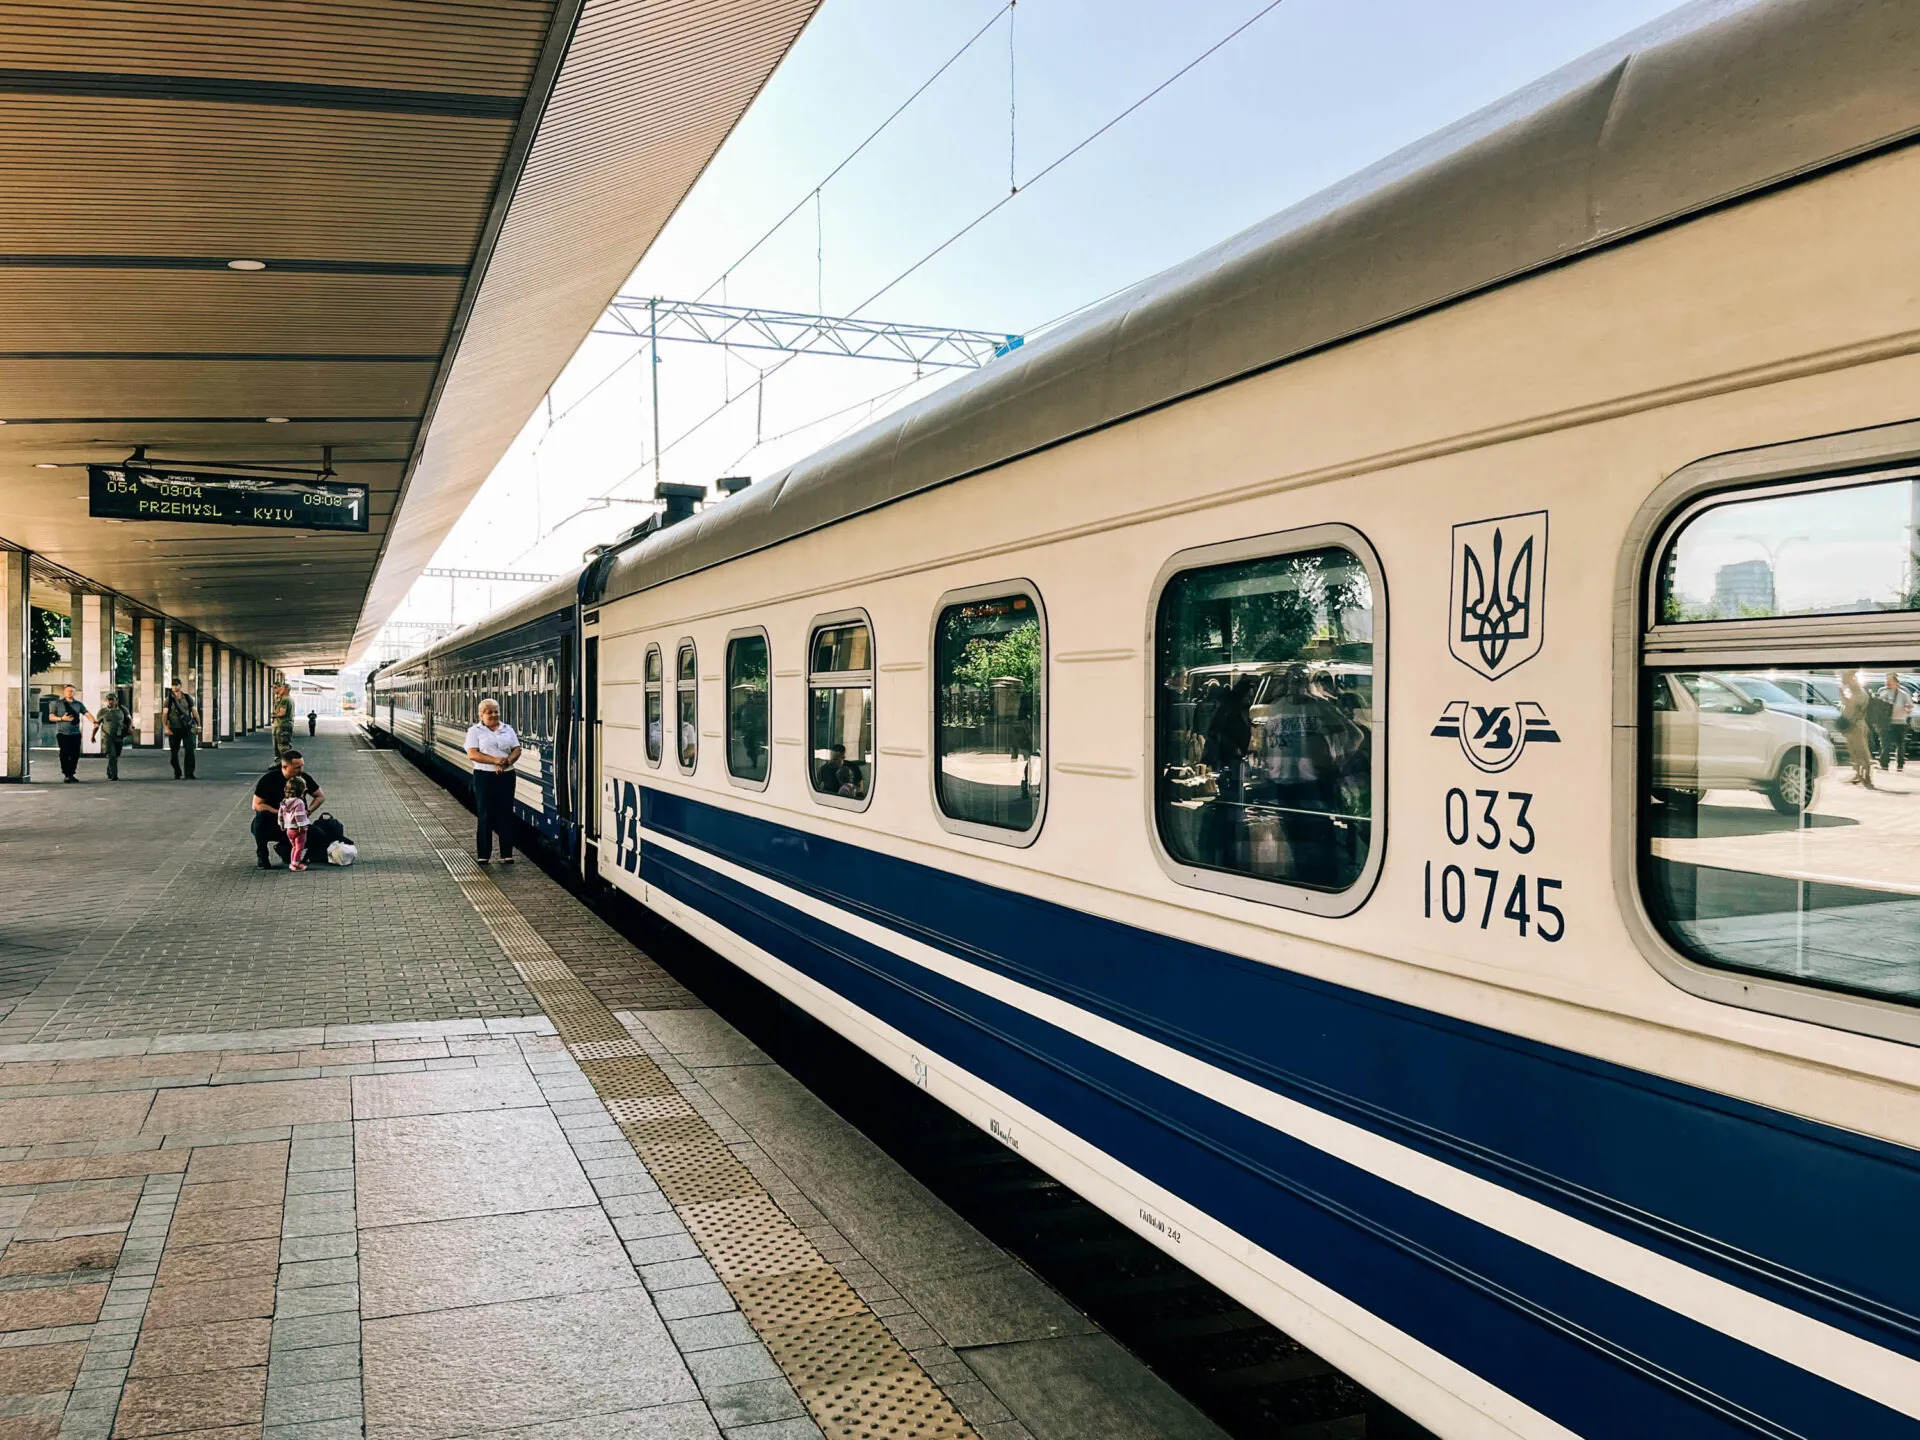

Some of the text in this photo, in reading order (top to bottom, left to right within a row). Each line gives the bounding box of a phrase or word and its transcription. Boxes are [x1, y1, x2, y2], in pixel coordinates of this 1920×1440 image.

[107, 481, 138, 495] 054
[160, 485, 202, 498] 09:04
[303, 494, 342, 507] 09:08
[139, 500, 223, 517] PRZEMYSL
[253, 506, 293, 520] KYIV
[347, 500, 359, 521] 1
[1445, 787, 1535, 855] 033
[1424, 860, 1565, 943] 10745
[1167, 1227, 1181, 1244] 242
